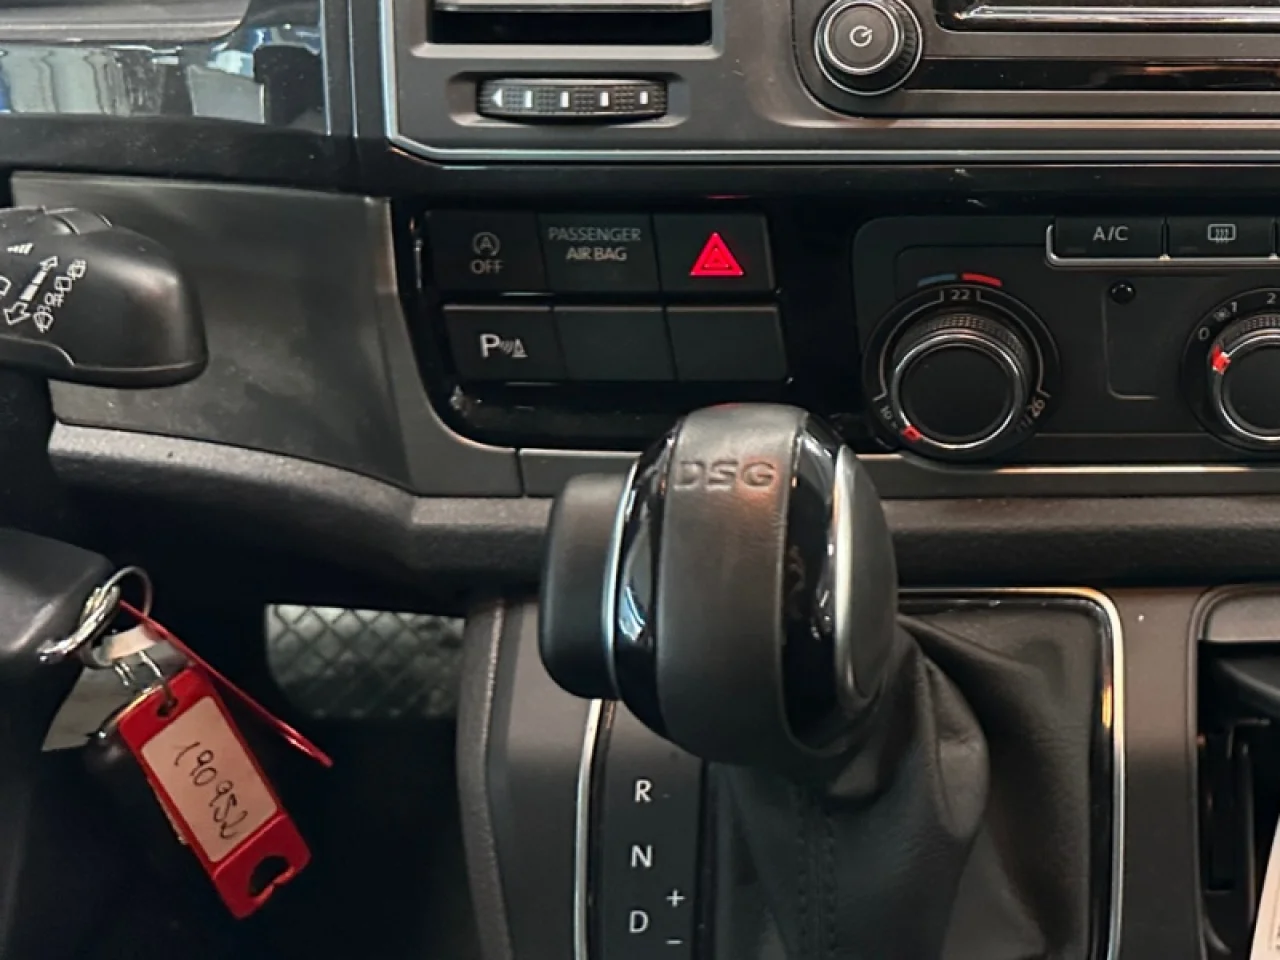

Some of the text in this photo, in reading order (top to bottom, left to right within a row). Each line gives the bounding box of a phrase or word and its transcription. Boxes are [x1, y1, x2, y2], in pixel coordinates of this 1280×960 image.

[548, 226, 642, 243] PASSENGER
[1093, 225, 1130, 242] A/C
[470, 259, 504, 275] OFF
[950, 288, 971, 301] 22
[1266, 292, 1277, 305] 2
[675, 459, 775, 490] DSG
[634, 779, 652, 803] R
[631, 844, 652, 868] N
[629, 909, 650, 934] D
